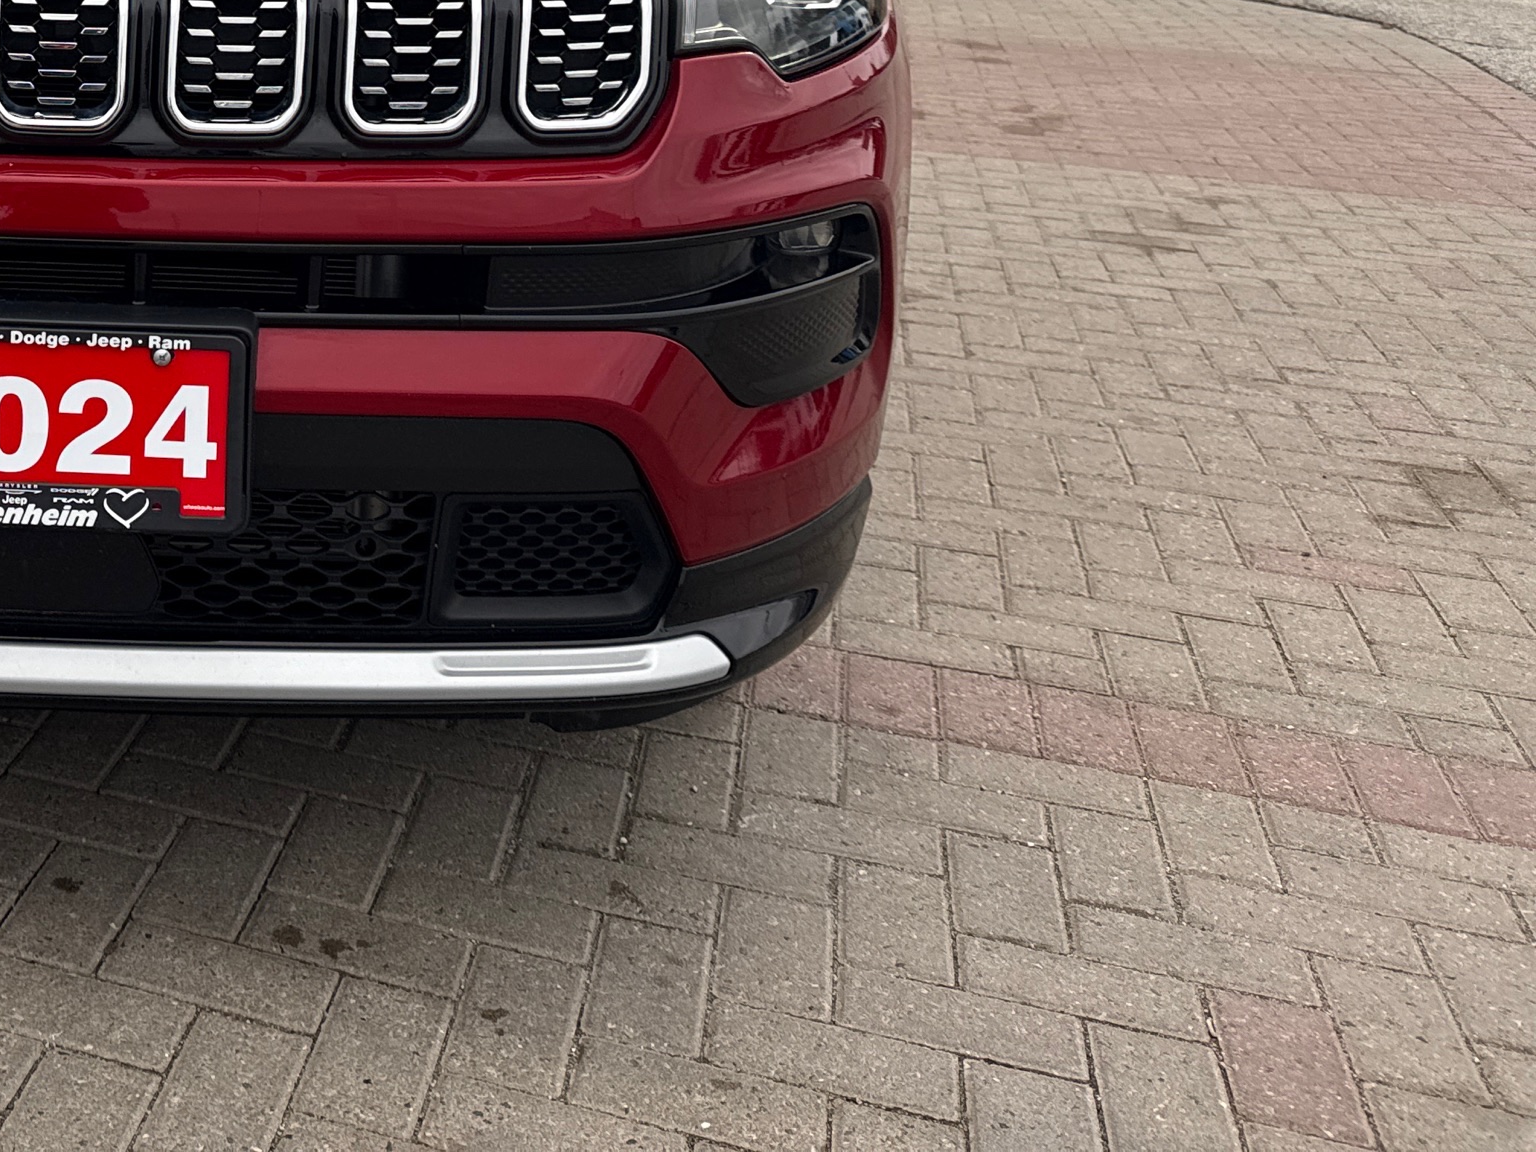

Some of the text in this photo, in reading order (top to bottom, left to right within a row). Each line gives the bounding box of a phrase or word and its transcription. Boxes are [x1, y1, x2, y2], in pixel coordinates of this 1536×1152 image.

[10, 331, 70, 348] Dodge
[86, 333, 132, 350] Jeep
[148, 335, 191, 350] Ram
[1, 494, 28, 506] Jeep
